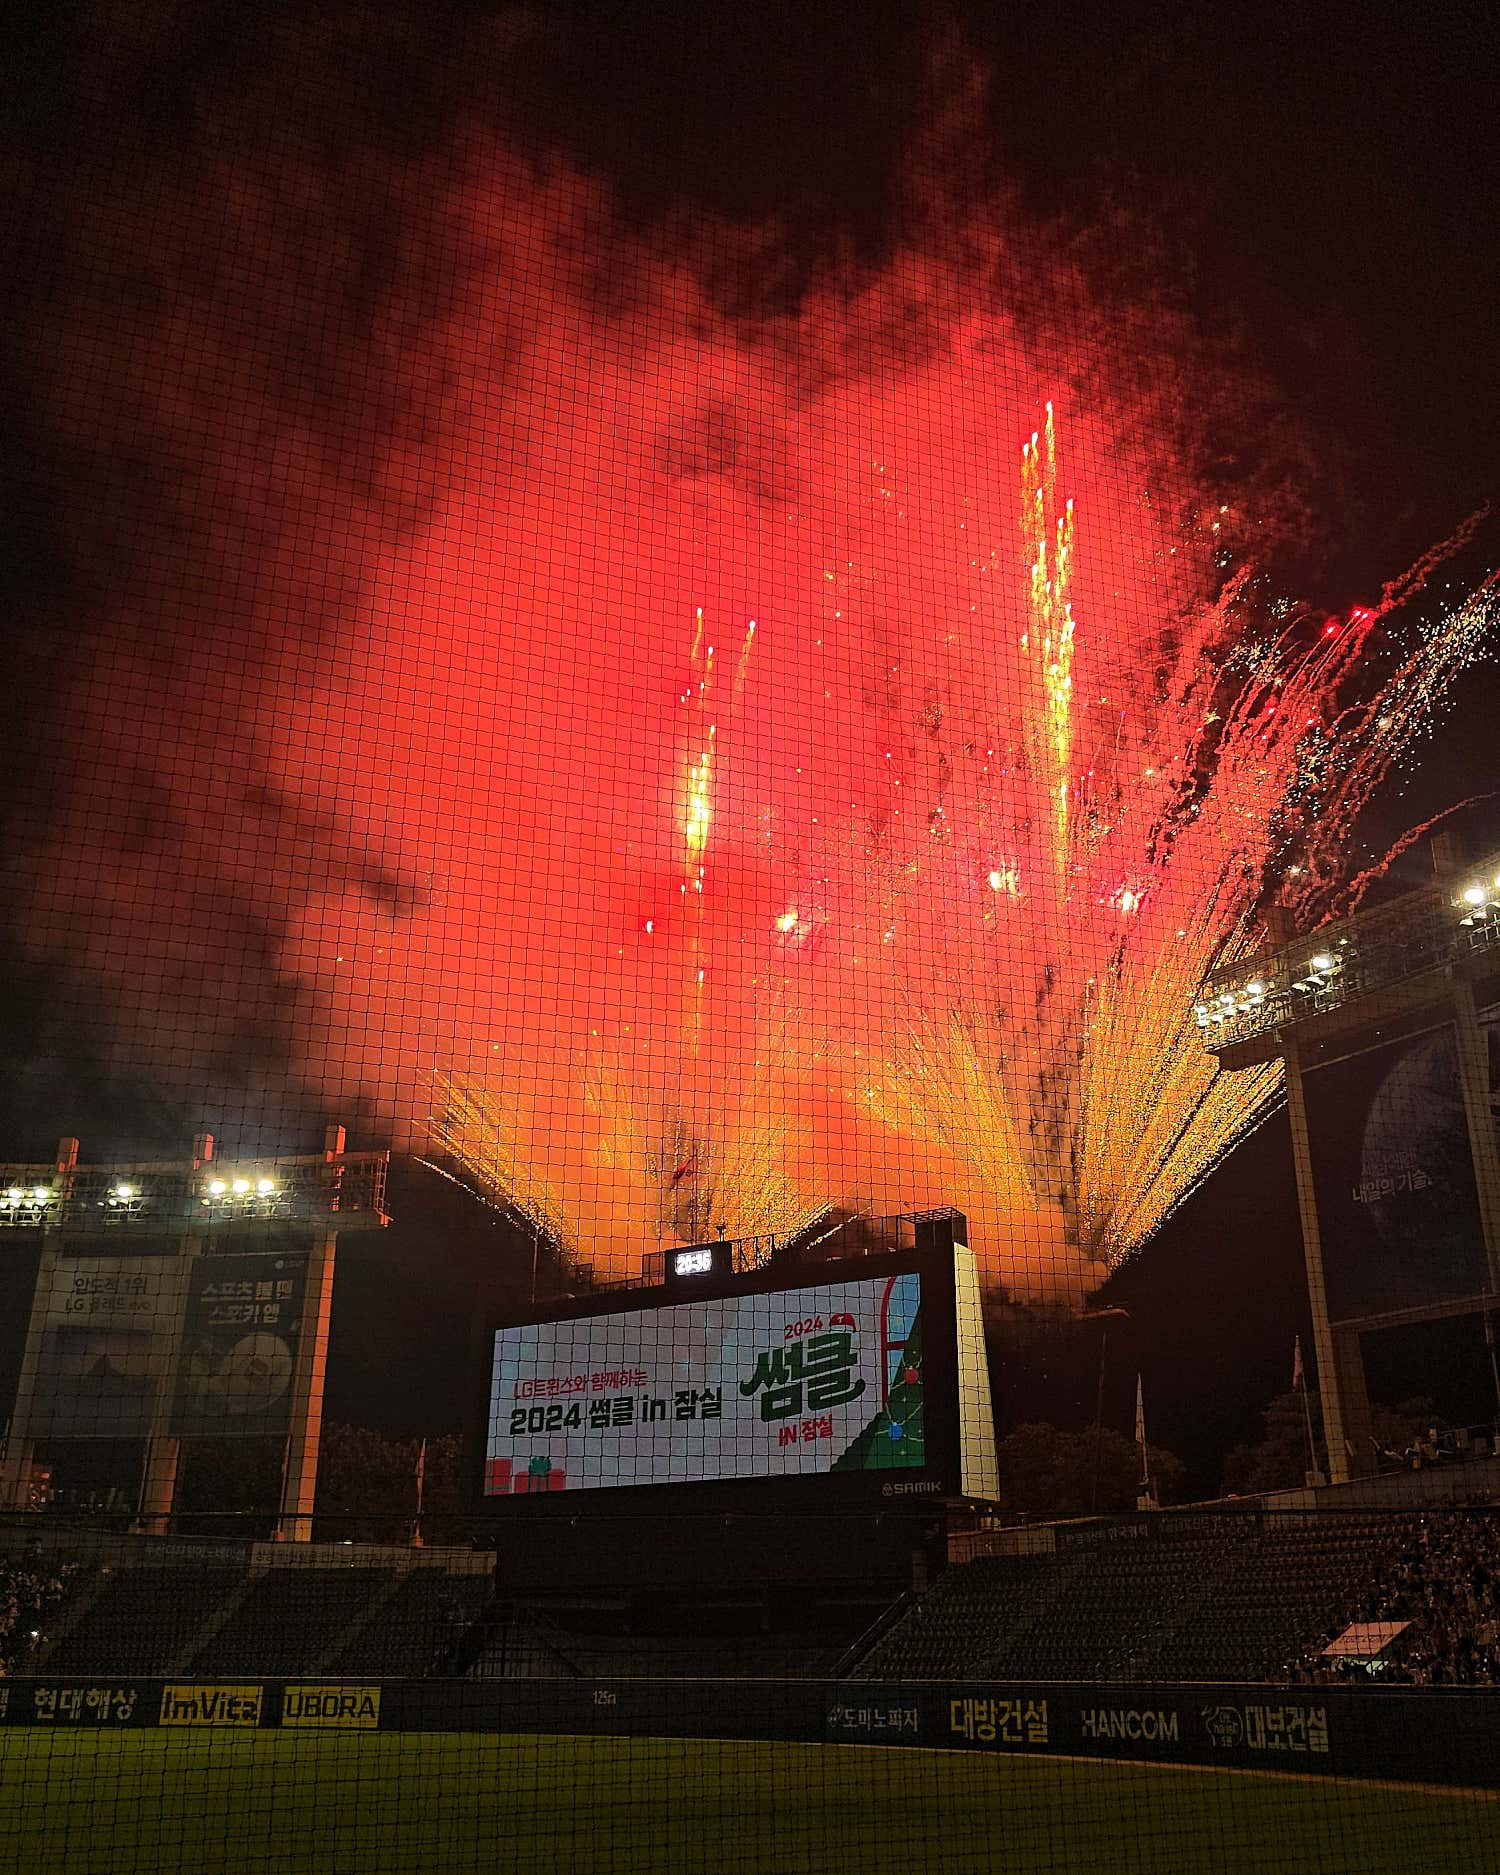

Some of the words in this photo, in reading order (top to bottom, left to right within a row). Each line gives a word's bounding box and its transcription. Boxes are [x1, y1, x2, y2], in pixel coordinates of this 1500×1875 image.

[125, 1276, 148, 1294] 1위
[200, 1280, 253, 1302] 스포츠
[65, 1298, 85, 1311] LG
[785, 1315, 823, 1340] 2024
[513, 1374, 587, 1399] LG트윈스와
[591, 1367, 649, 1391] 함께하는
[740, 1330, 866, 1422] 썸클
[509, 1403, 581, 1435] 2024
[589, 1396, 635, 1429] 썸클
[641, 1394, 666, 1422] in
[674, 1387, 722, 1421] 잠실
[778, 1424, 797, 1446] IN
[800, 1413, 834, 1443] 잠실
[894, 1480, 942, 1495] SAMIK
[33, 1687, 138, 1720] 현대해상
[949, 1697, 1049, 1743] 대방건설
[1081, 1708, 1180, 1742] HANCOM
[1245, 1704, 1329, 1752] 대보건설
